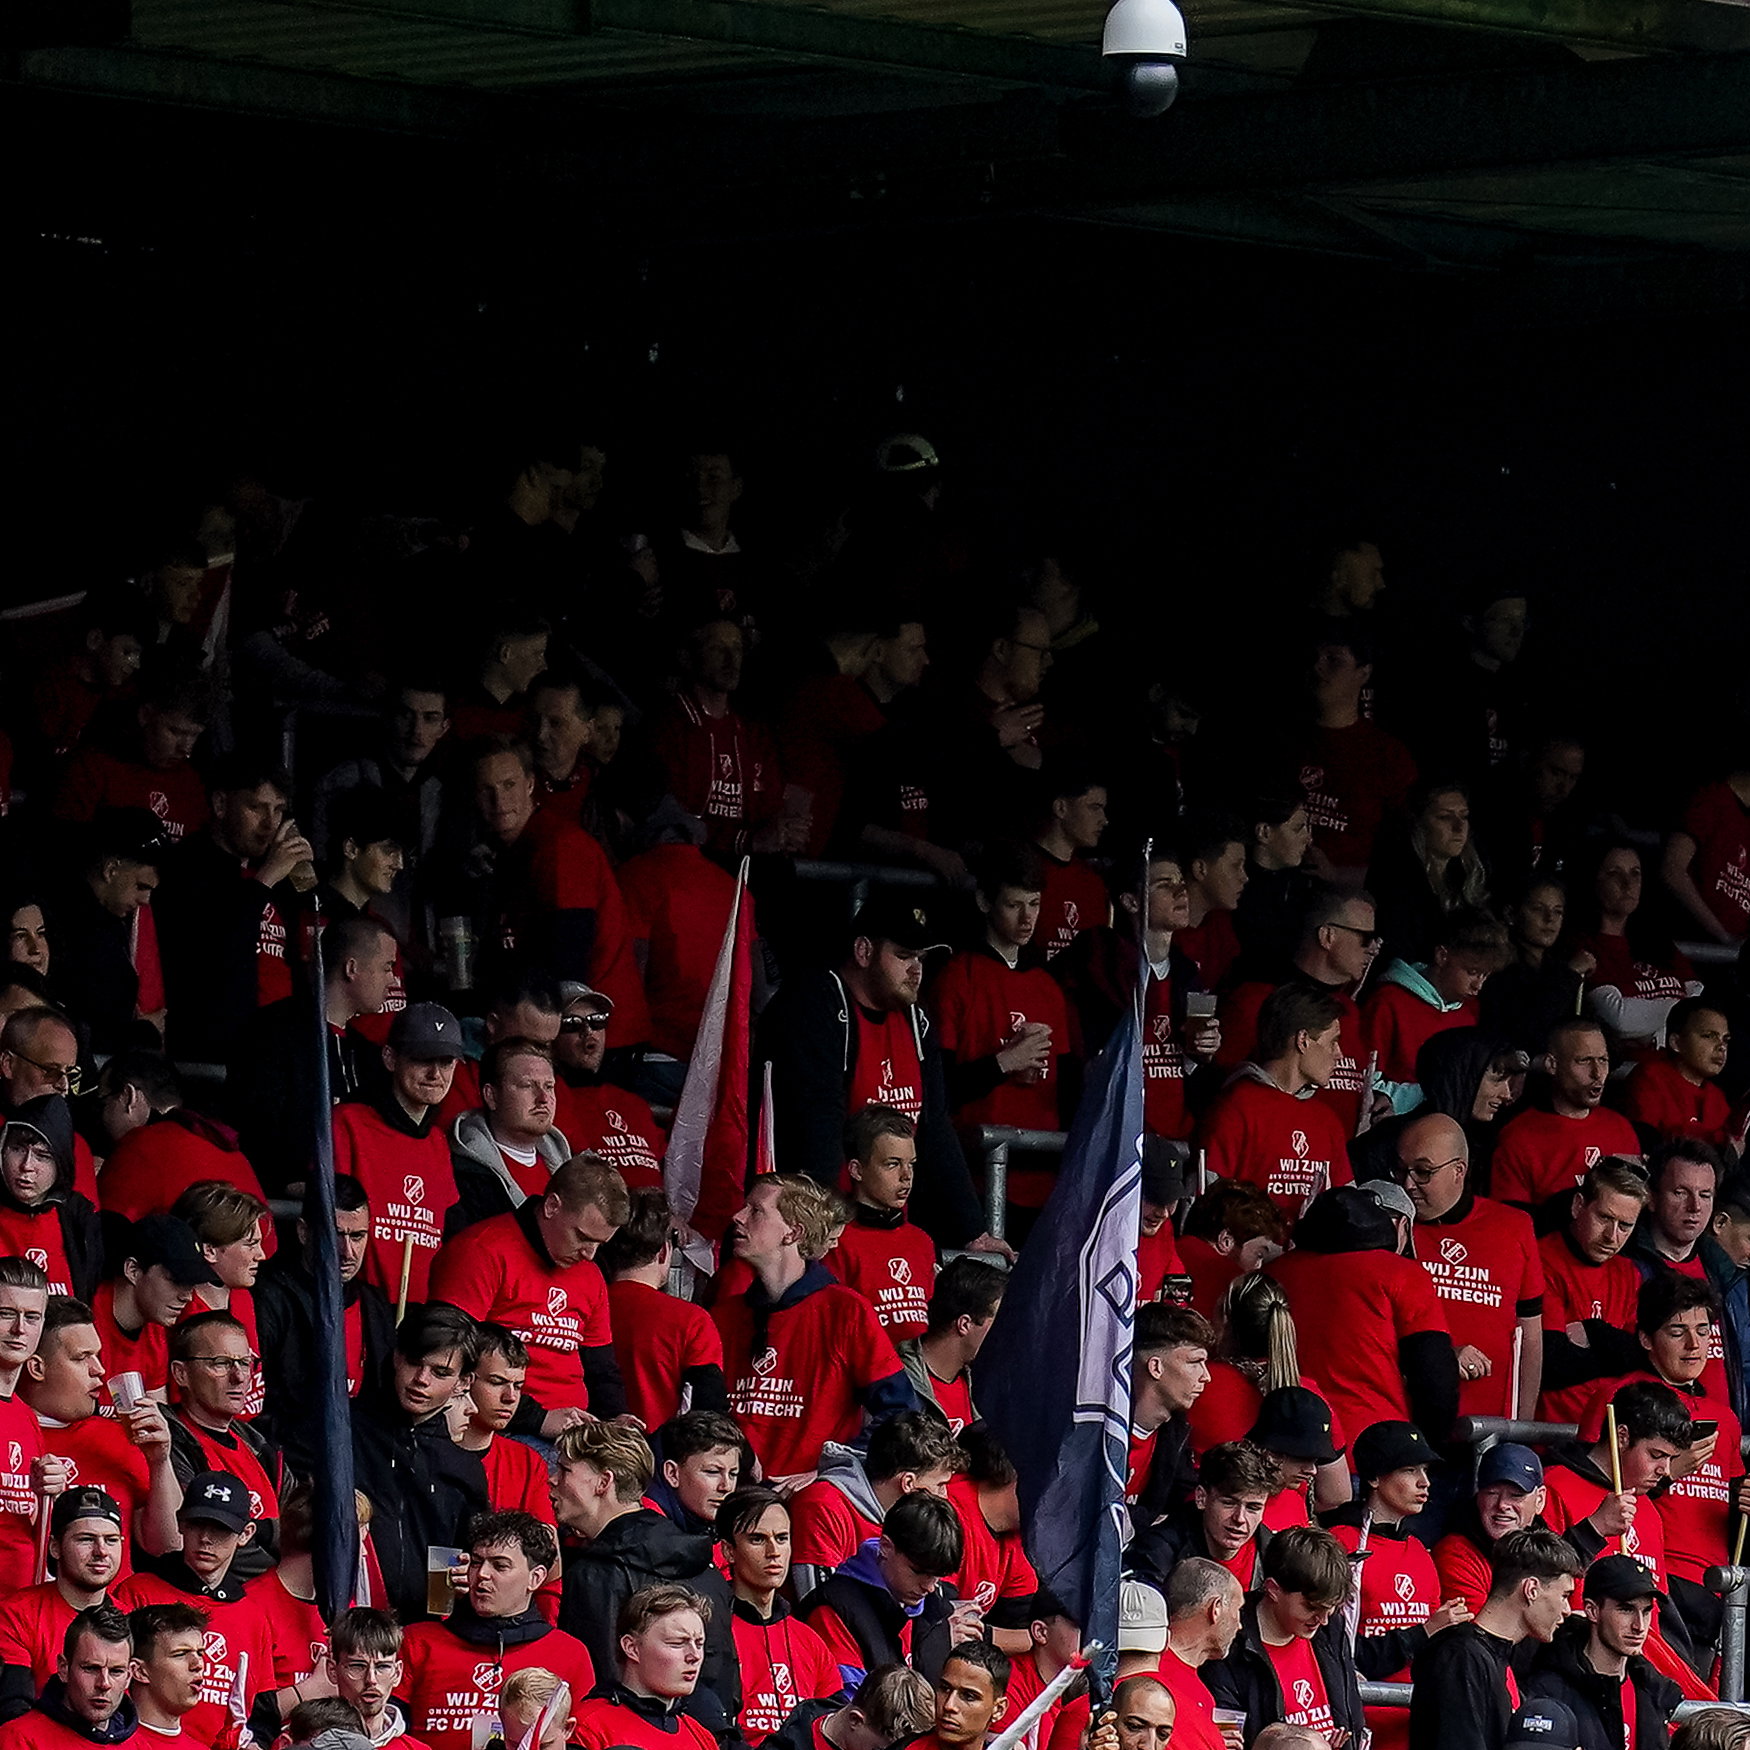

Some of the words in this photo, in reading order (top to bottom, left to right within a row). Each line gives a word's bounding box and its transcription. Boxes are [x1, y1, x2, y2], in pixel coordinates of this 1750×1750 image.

[1280, 1159, 1299, 1171] WIJ
[1268, 1182, 1283, 1194] FC
[388, 1203, 410, 1218] WIJ
[375, 1226, 391, 1239] FC
[1422, 1262, 1450, 1276] WIJ
[1455, 1266, 1488, 1281] ZIJN
[879, 1287, 902, 1301] WIJ
[760, 1378, 793, 1392] ZIJN
[737, 1401, 804, 1417] UTRECHT
[1670, 1483, 1684, 1495] FC
[1687, 1484, 1729, 1503] UTRECHT
[1380, 1603, 1405, 1615] WIJ
[1408, 1603, 1429, 1615] ZIJN
[447, 1693, 478, 1706] WIJ
[427, 1718, 448, 1730] FC
